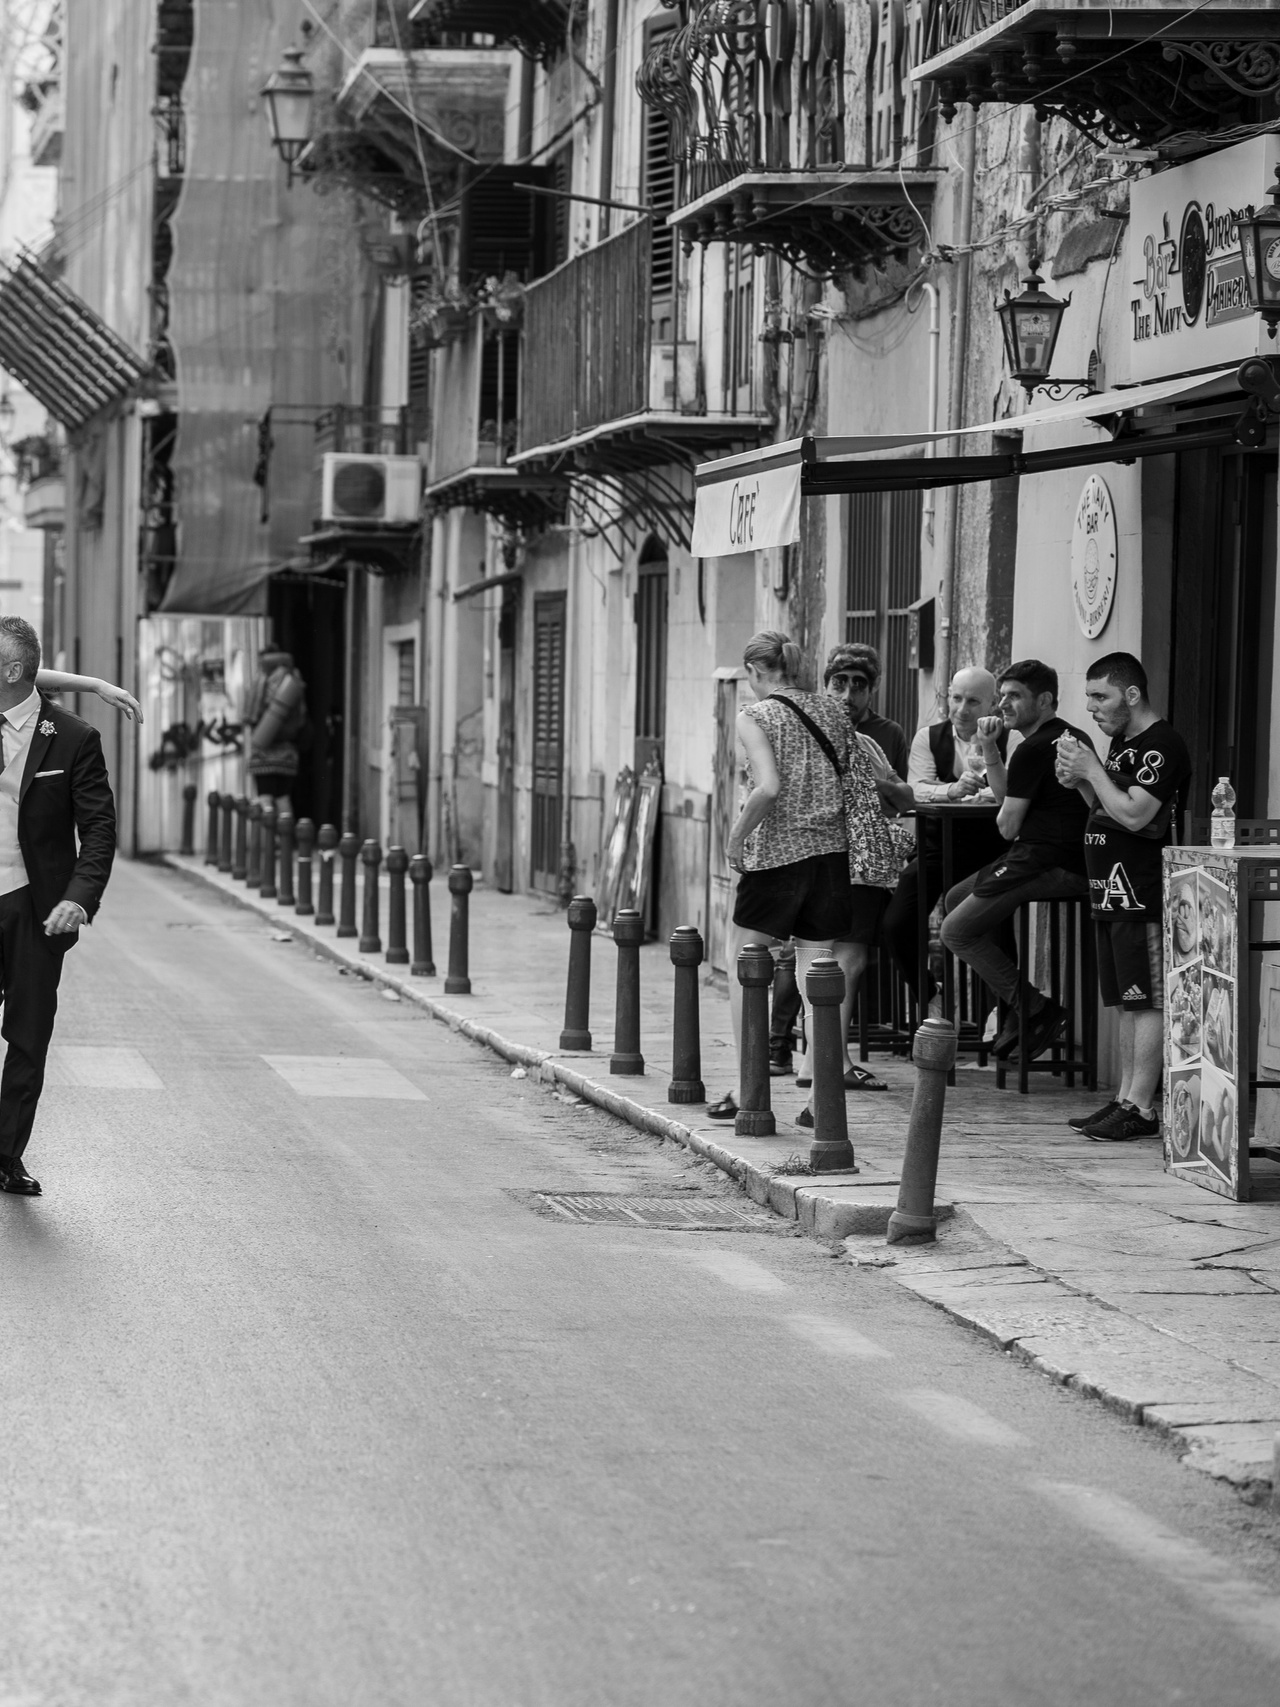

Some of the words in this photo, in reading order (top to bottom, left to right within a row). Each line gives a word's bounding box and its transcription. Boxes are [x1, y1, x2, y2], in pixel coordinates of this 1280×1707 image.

[1143, 235, 1170, 299] Bar
[1131, 299, 1150, 341] THE
[1153, 292, 1181, 335] NAVY
[1077, 488, 1091, 530] THE
[1086, 512, 1099, 534] BAR
[1136, 750, 1165, 785] 8
[1101, 862, 1146, 911] A
